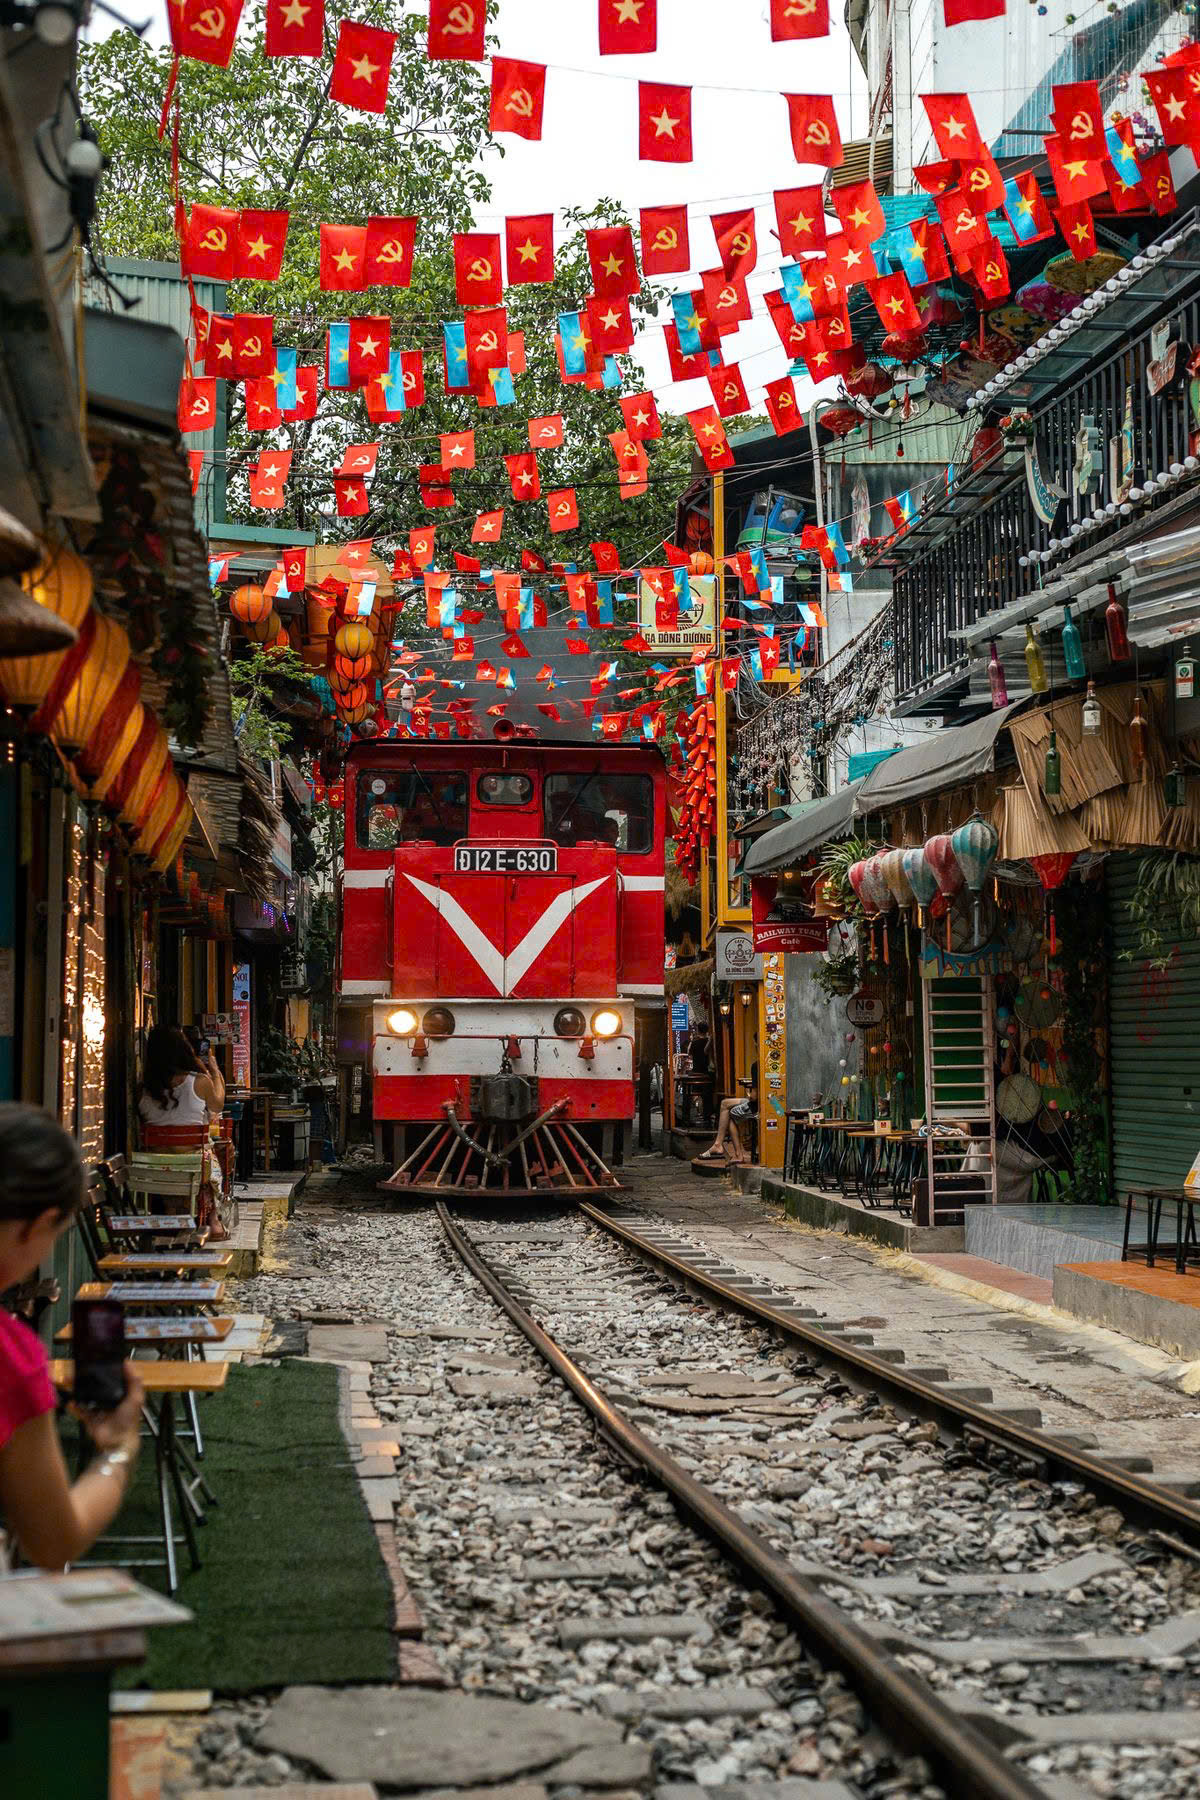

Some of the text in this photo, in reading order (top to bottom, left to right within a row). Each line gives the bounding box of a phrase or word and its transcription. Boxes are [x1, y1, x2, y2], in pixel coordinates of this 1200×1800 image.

[645, 633, 656, 643] GA
[757, 928, 822, 940] RAILWAY TUAN
[855, 1000, 875, 1010] NO
